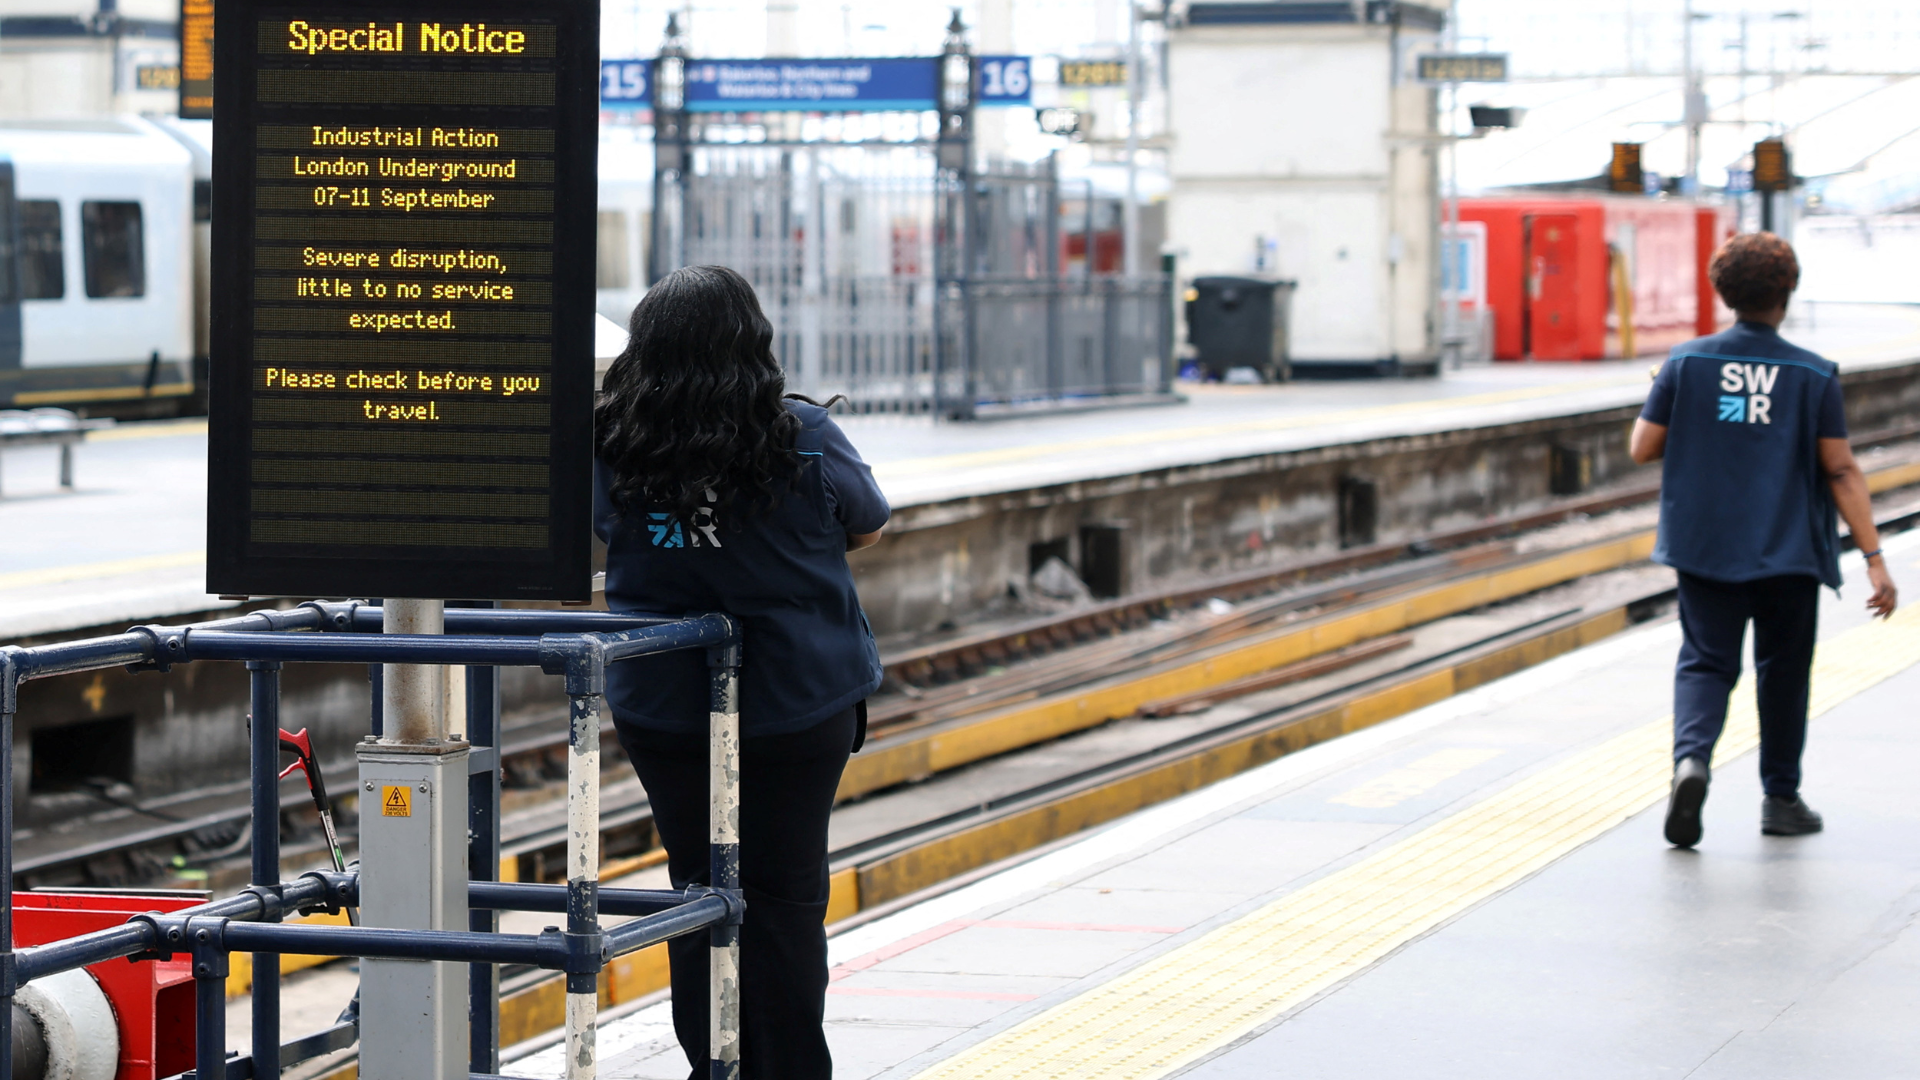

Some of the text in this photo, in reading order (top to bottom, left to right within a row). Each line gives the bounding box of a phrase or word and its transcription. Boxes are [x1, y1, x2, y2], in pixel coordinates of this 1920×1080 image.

[288, 20, 525, 55] Special Notice
[602, 63, 646, 99] 15
[982, 60, 1028, 96] 16
[312, 125, 499, 148] Industrial Action
[294, 155, 516, 182] London Underground
[314, 186, 495, 212] 07-11 September
[303, 246, 507, 275] Severe disruption,
[297, 277, 514, 300] little to no service
[349, 309, 456, 333] expected.
[266, 367, 540, 396] Please check before you
[1720, 362, 1780, 395] SW
[363, 399, 440, 420] travel.
[1748, 394, 1771, 424] R
